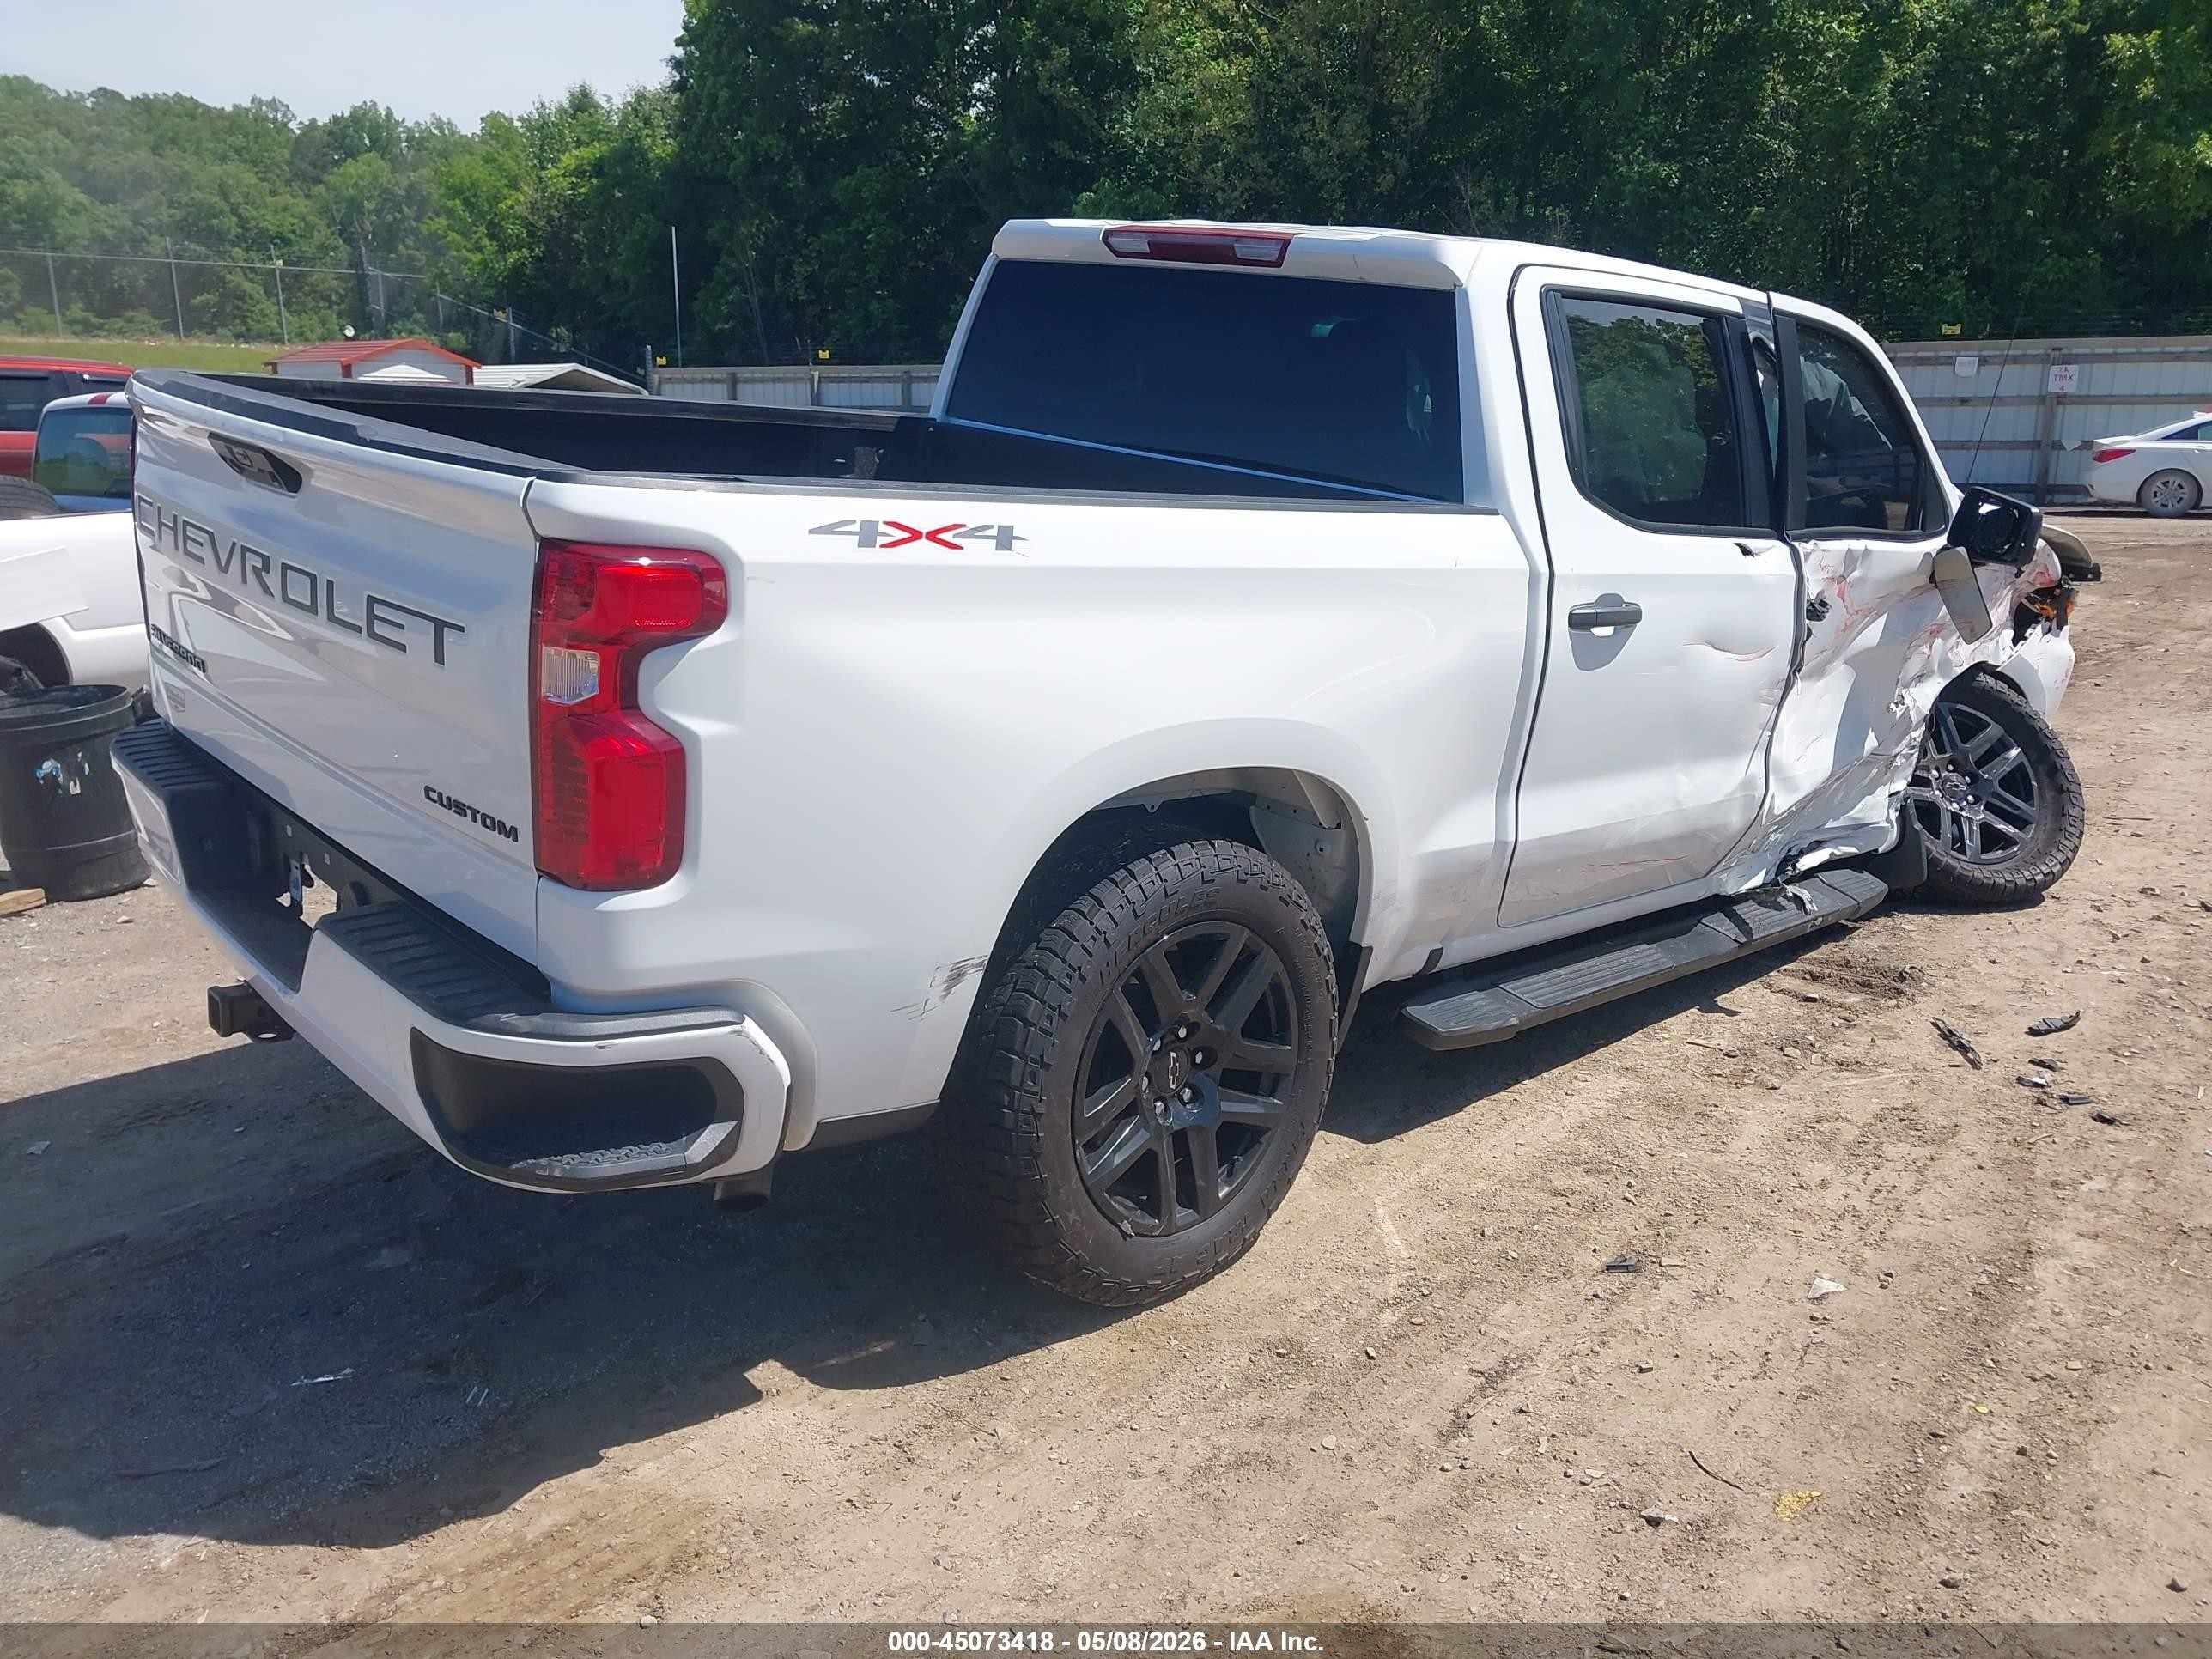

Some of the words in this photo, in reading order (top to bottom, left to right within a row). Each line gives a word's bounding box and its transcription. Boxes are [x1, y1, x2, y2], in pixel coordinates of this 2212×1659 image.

[2053, 374, 2075, 382] TMX
[137, 495, 465, 666] CHEVROLET
[424, 785, 519, 842] CUSTOM
